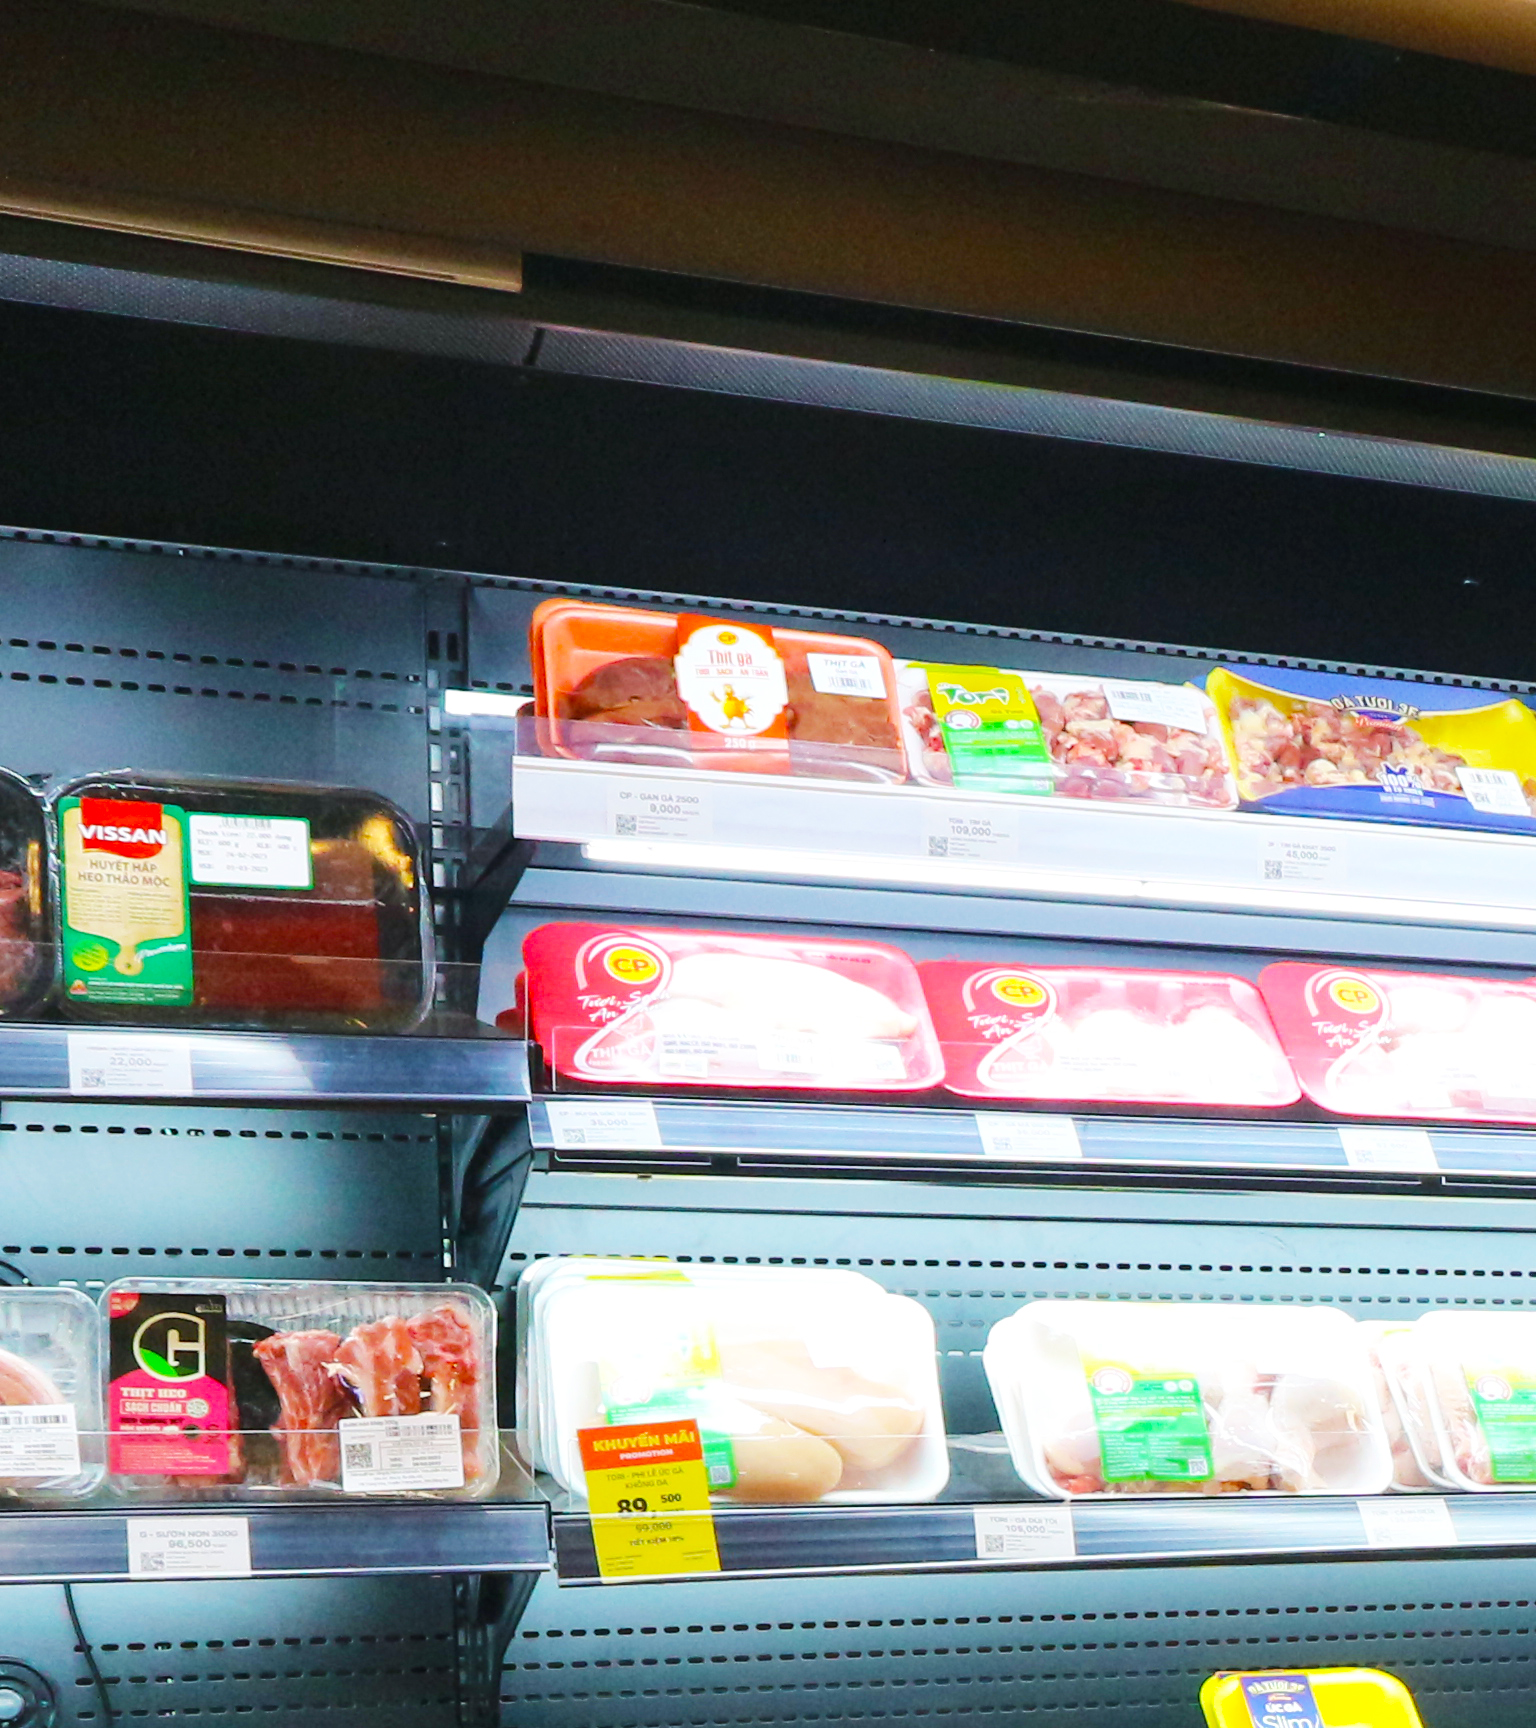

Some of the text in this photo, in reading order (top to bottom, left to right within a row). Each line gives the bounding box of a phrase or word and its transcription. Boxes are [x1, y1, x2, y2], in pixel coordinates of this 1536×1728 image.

[78, 823, 168, 846] VISSAN
[78, 870, 104, 883] HEO
[613, 957, 651, 974] CP
[1001, 986, 1036, 998] CP
[1338, 988, 1368, 1003] CP
[593, 1429, 696, 1453] KHUYẾN MÃI
[620, 1449, 674, 1460] PROMOTION
[660, 1493, 680, 1504] 500
